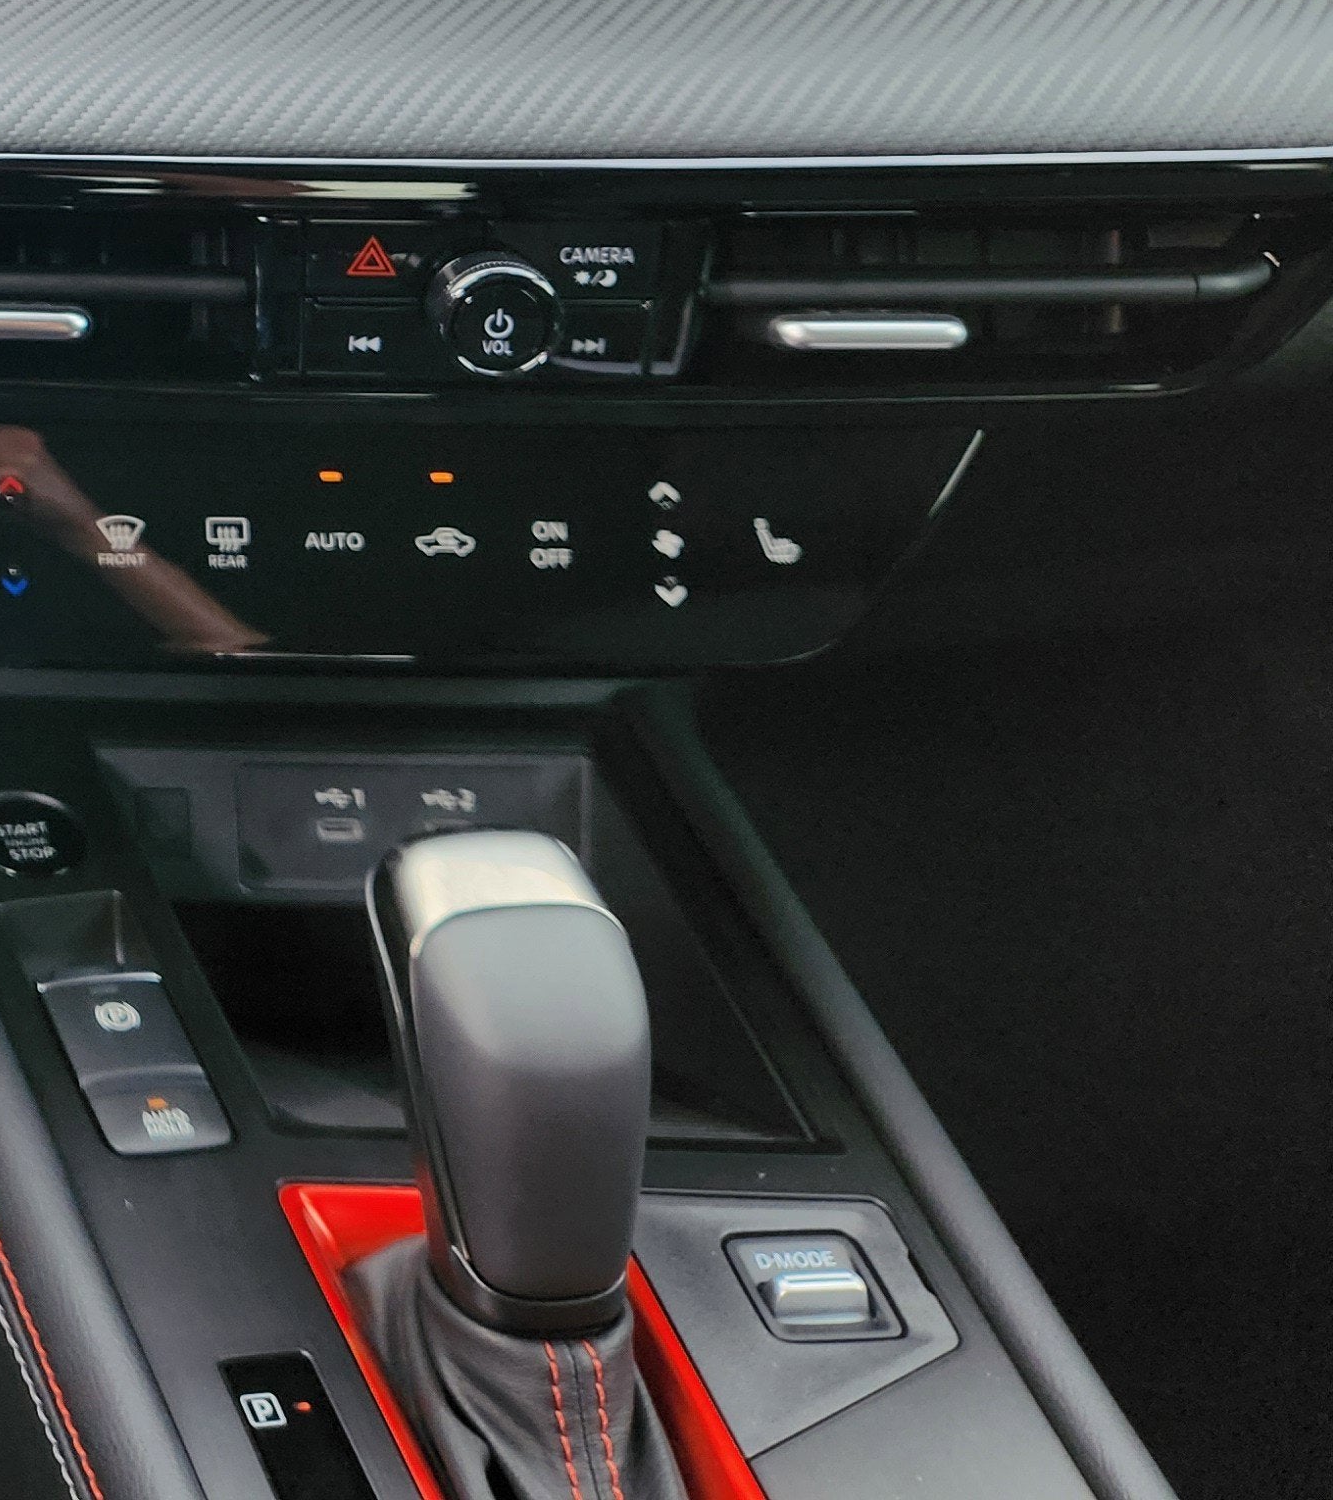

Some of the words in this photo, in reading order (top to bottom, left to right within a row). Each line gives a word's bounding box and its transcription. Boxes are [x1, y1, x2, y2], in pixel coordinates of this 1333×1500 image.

[559, 246, 636, 265] CAMERA
[482, 339, 515, 356] VOL
[531, 520, 570, 542] ON
[304, 531, 367, 552] AUTO
[97, 552, 146, 569] FRONT
[207, 553, 249, 570] REAR
[529, 547, 574, 569] OFF
[8, 845, 57, 861] STOP
